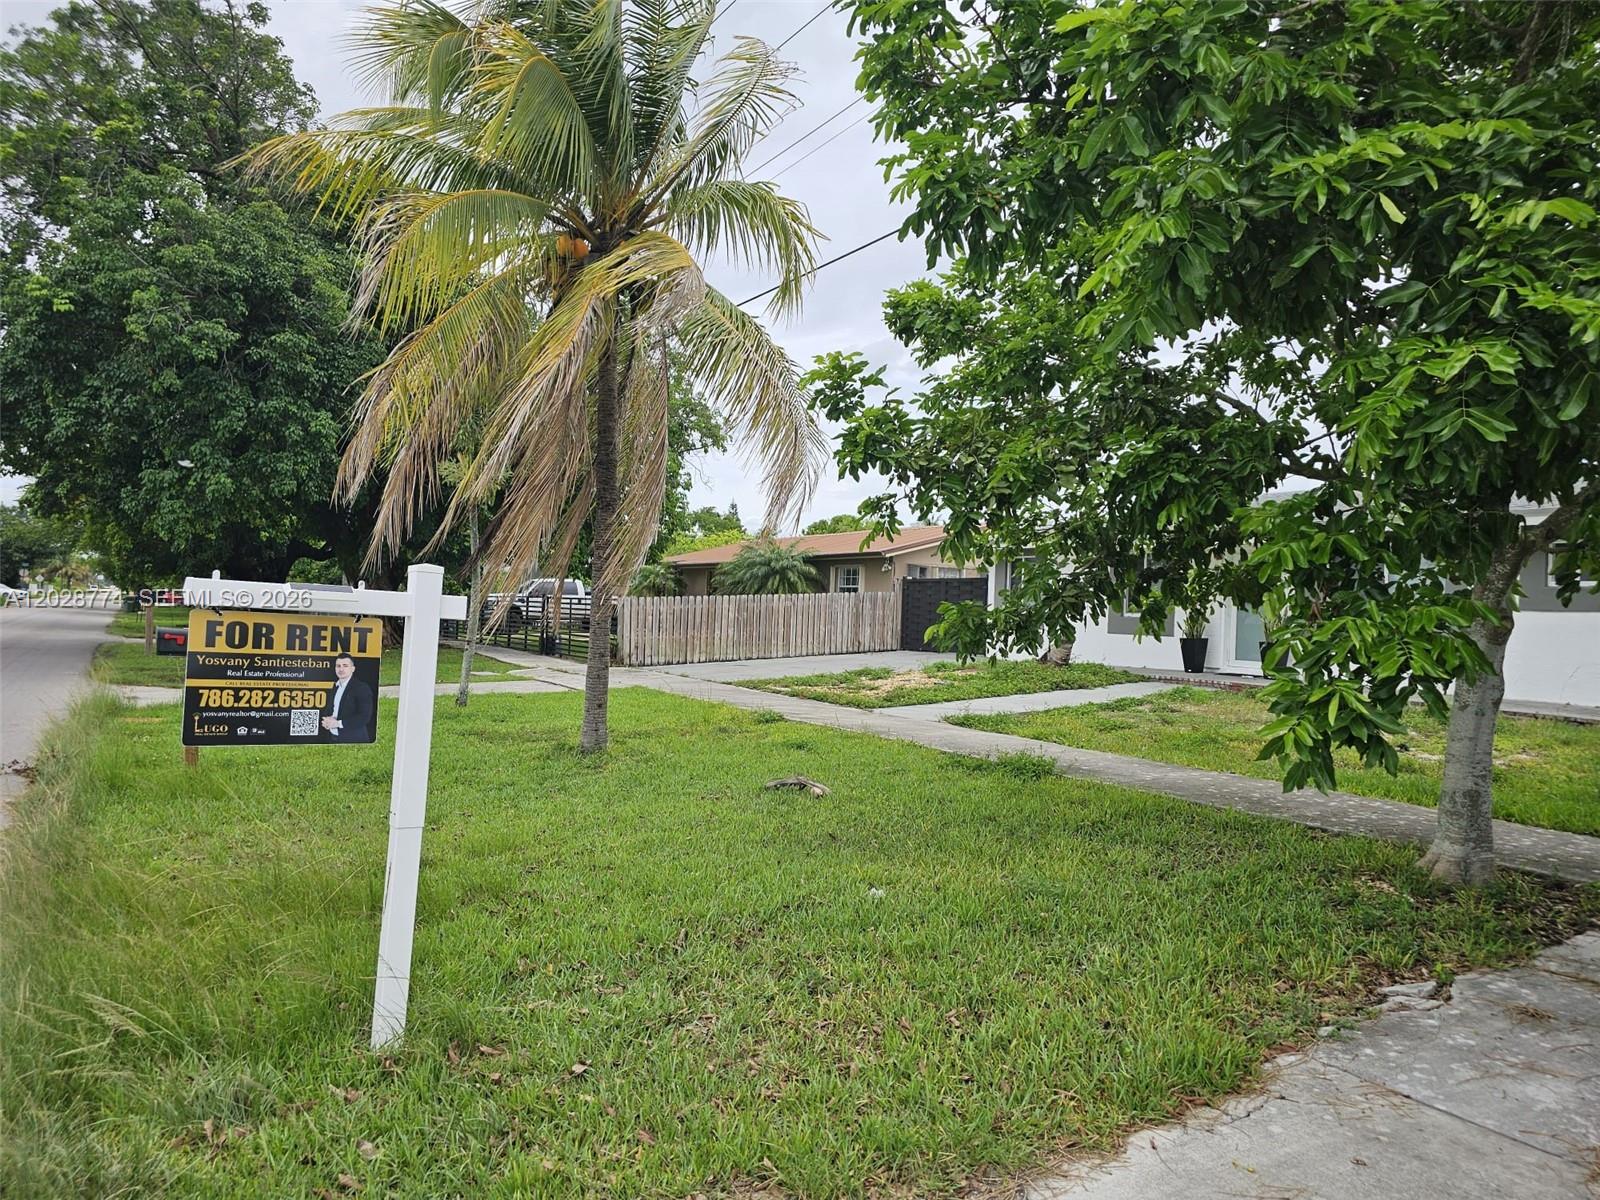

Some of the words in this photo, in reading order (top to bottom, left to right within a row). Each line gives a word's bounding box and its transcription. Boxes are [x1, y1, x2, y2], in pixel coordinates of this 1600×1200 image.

[204, 619, 275, 650] FOR
[286, 623, 374, 653] RENT
[197, 655, 250, 668] Yosvany
[254, 656, 330, 668] Santiesteban
[226, 669, 243, 677] Real
[244, 669, 264, 677] Estate
[265, 670, 305, 678] Professional
[198, 689, 327, 708] 786.282.6350
